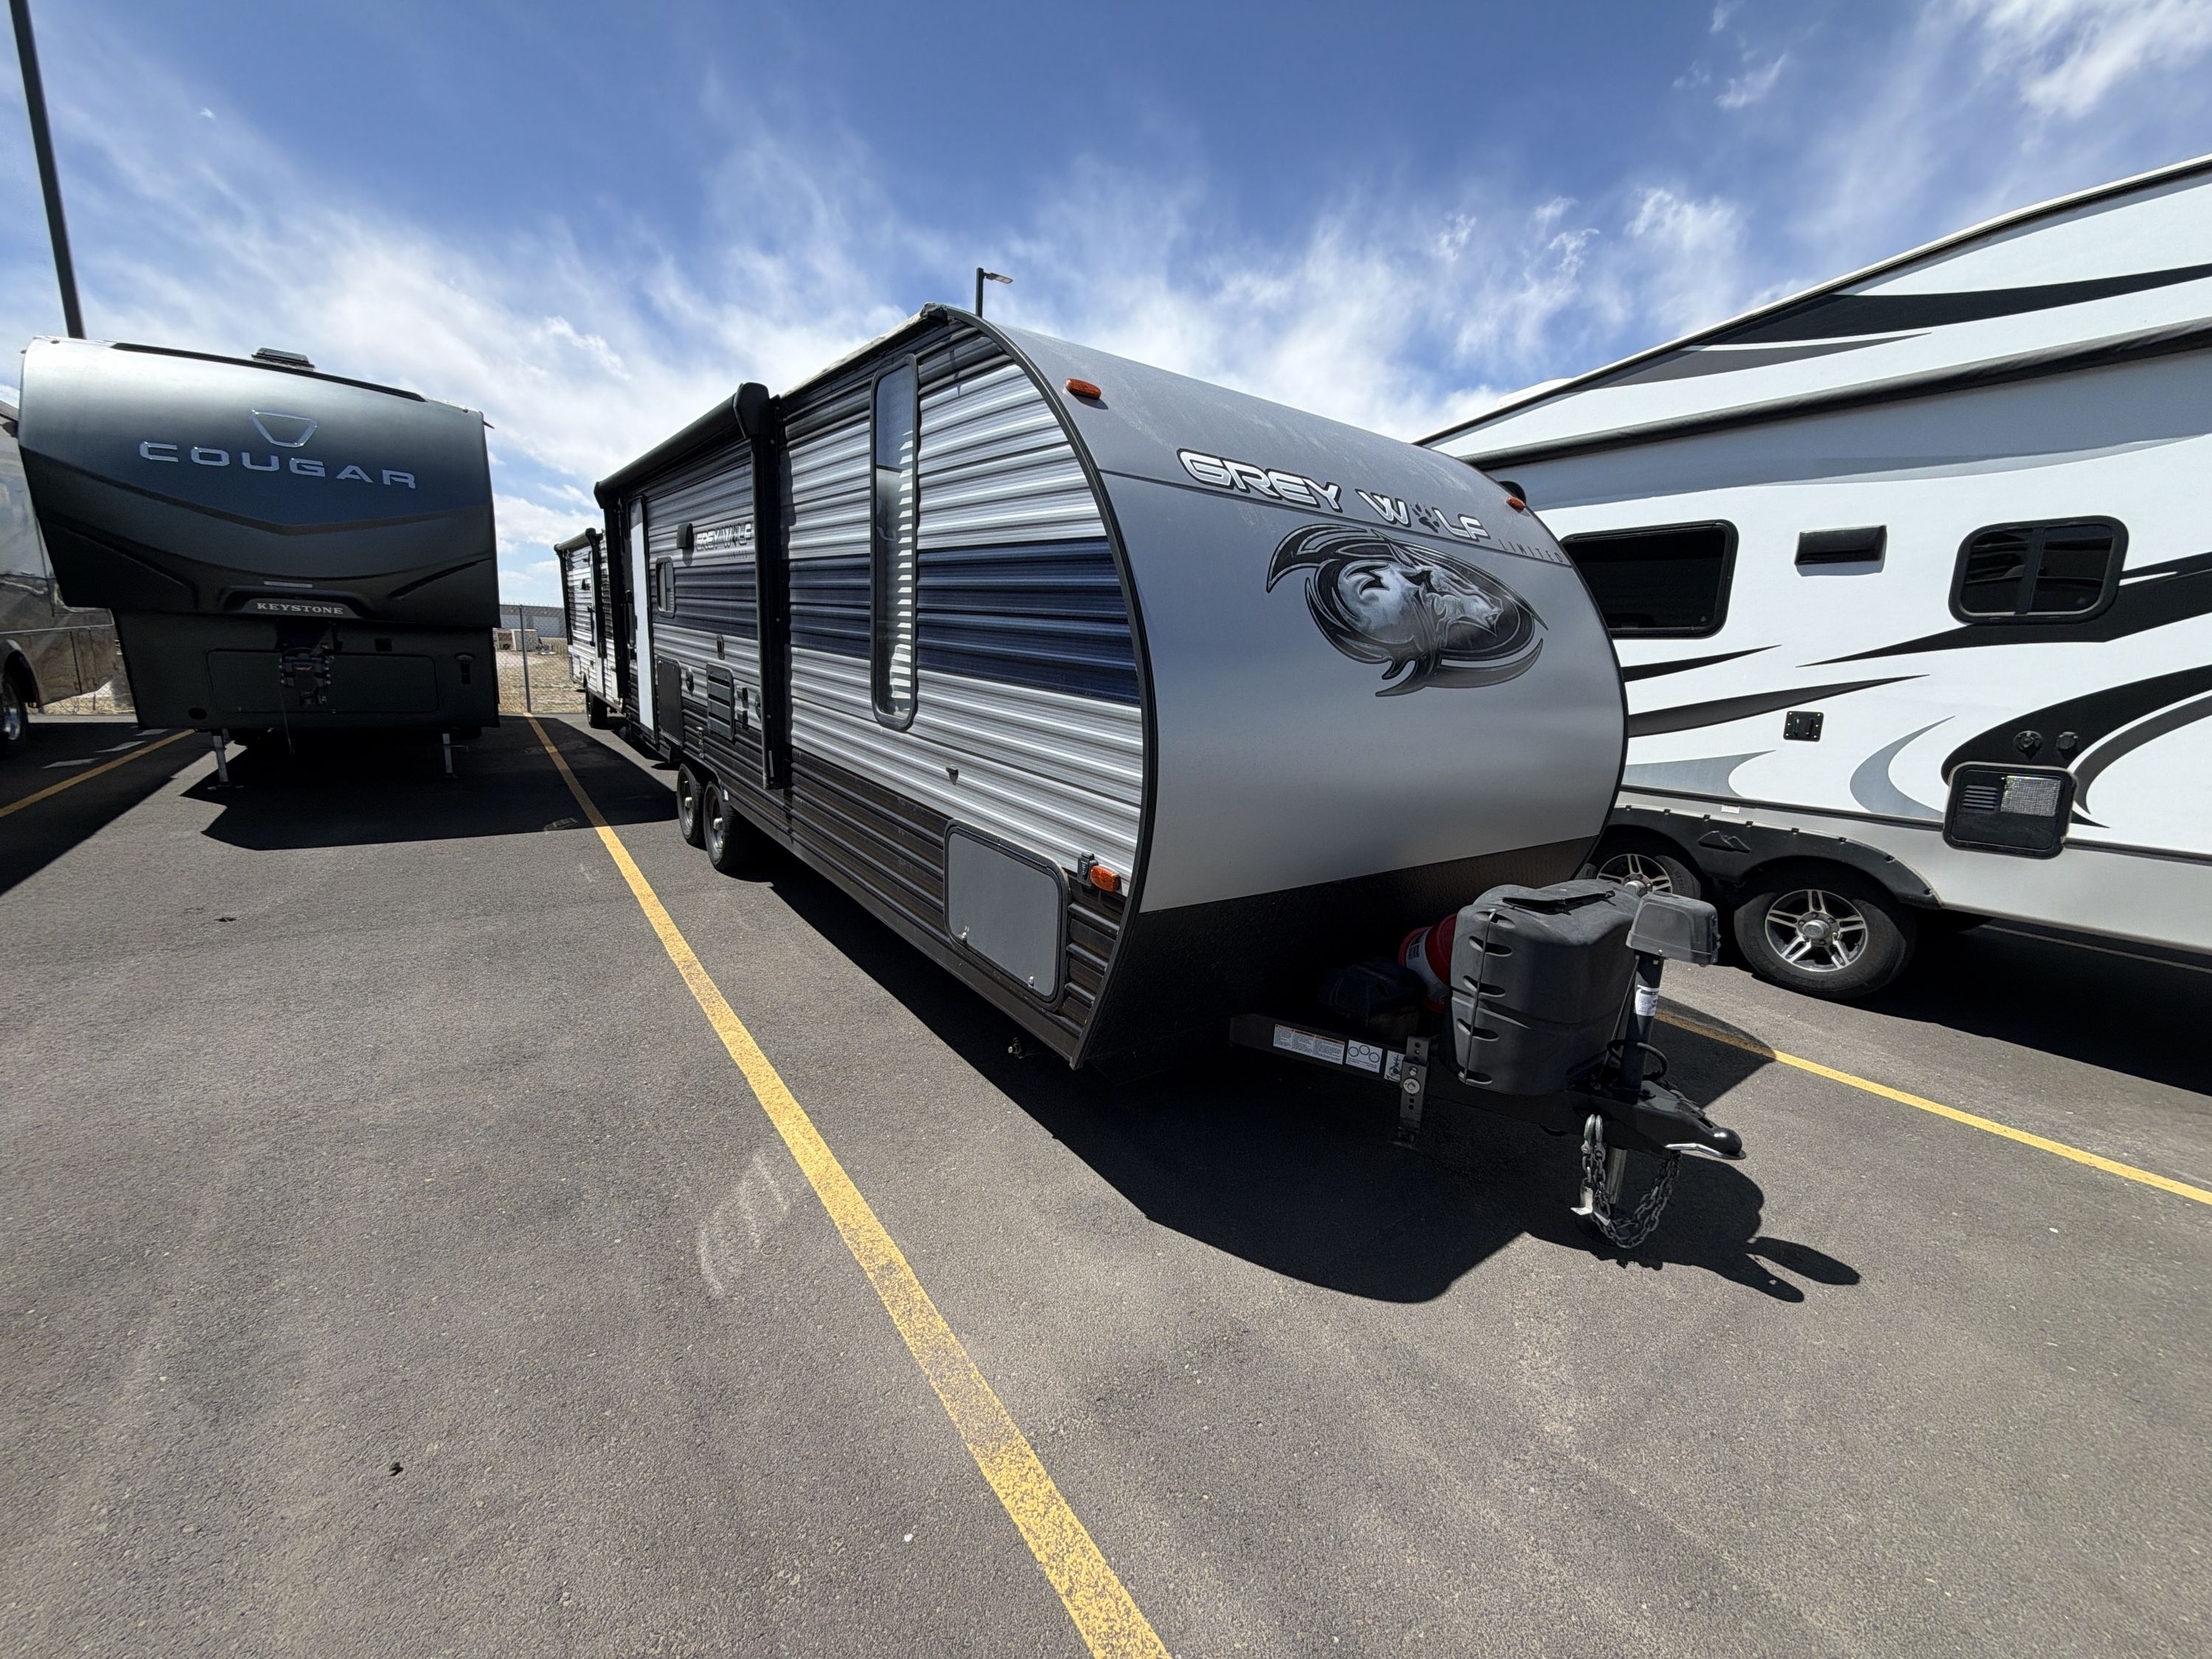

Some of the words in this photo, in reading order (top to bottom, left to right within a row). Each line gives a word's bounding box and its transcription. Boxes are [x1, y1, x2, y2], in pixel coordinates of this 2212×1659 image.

[139, 441, 417, 489] COUGAR
[1176, 448, 1342, 512] GREY
[1498, 538, 1563, 563] LIMITED
[257, 602, 344, 615] KEYSTONE
